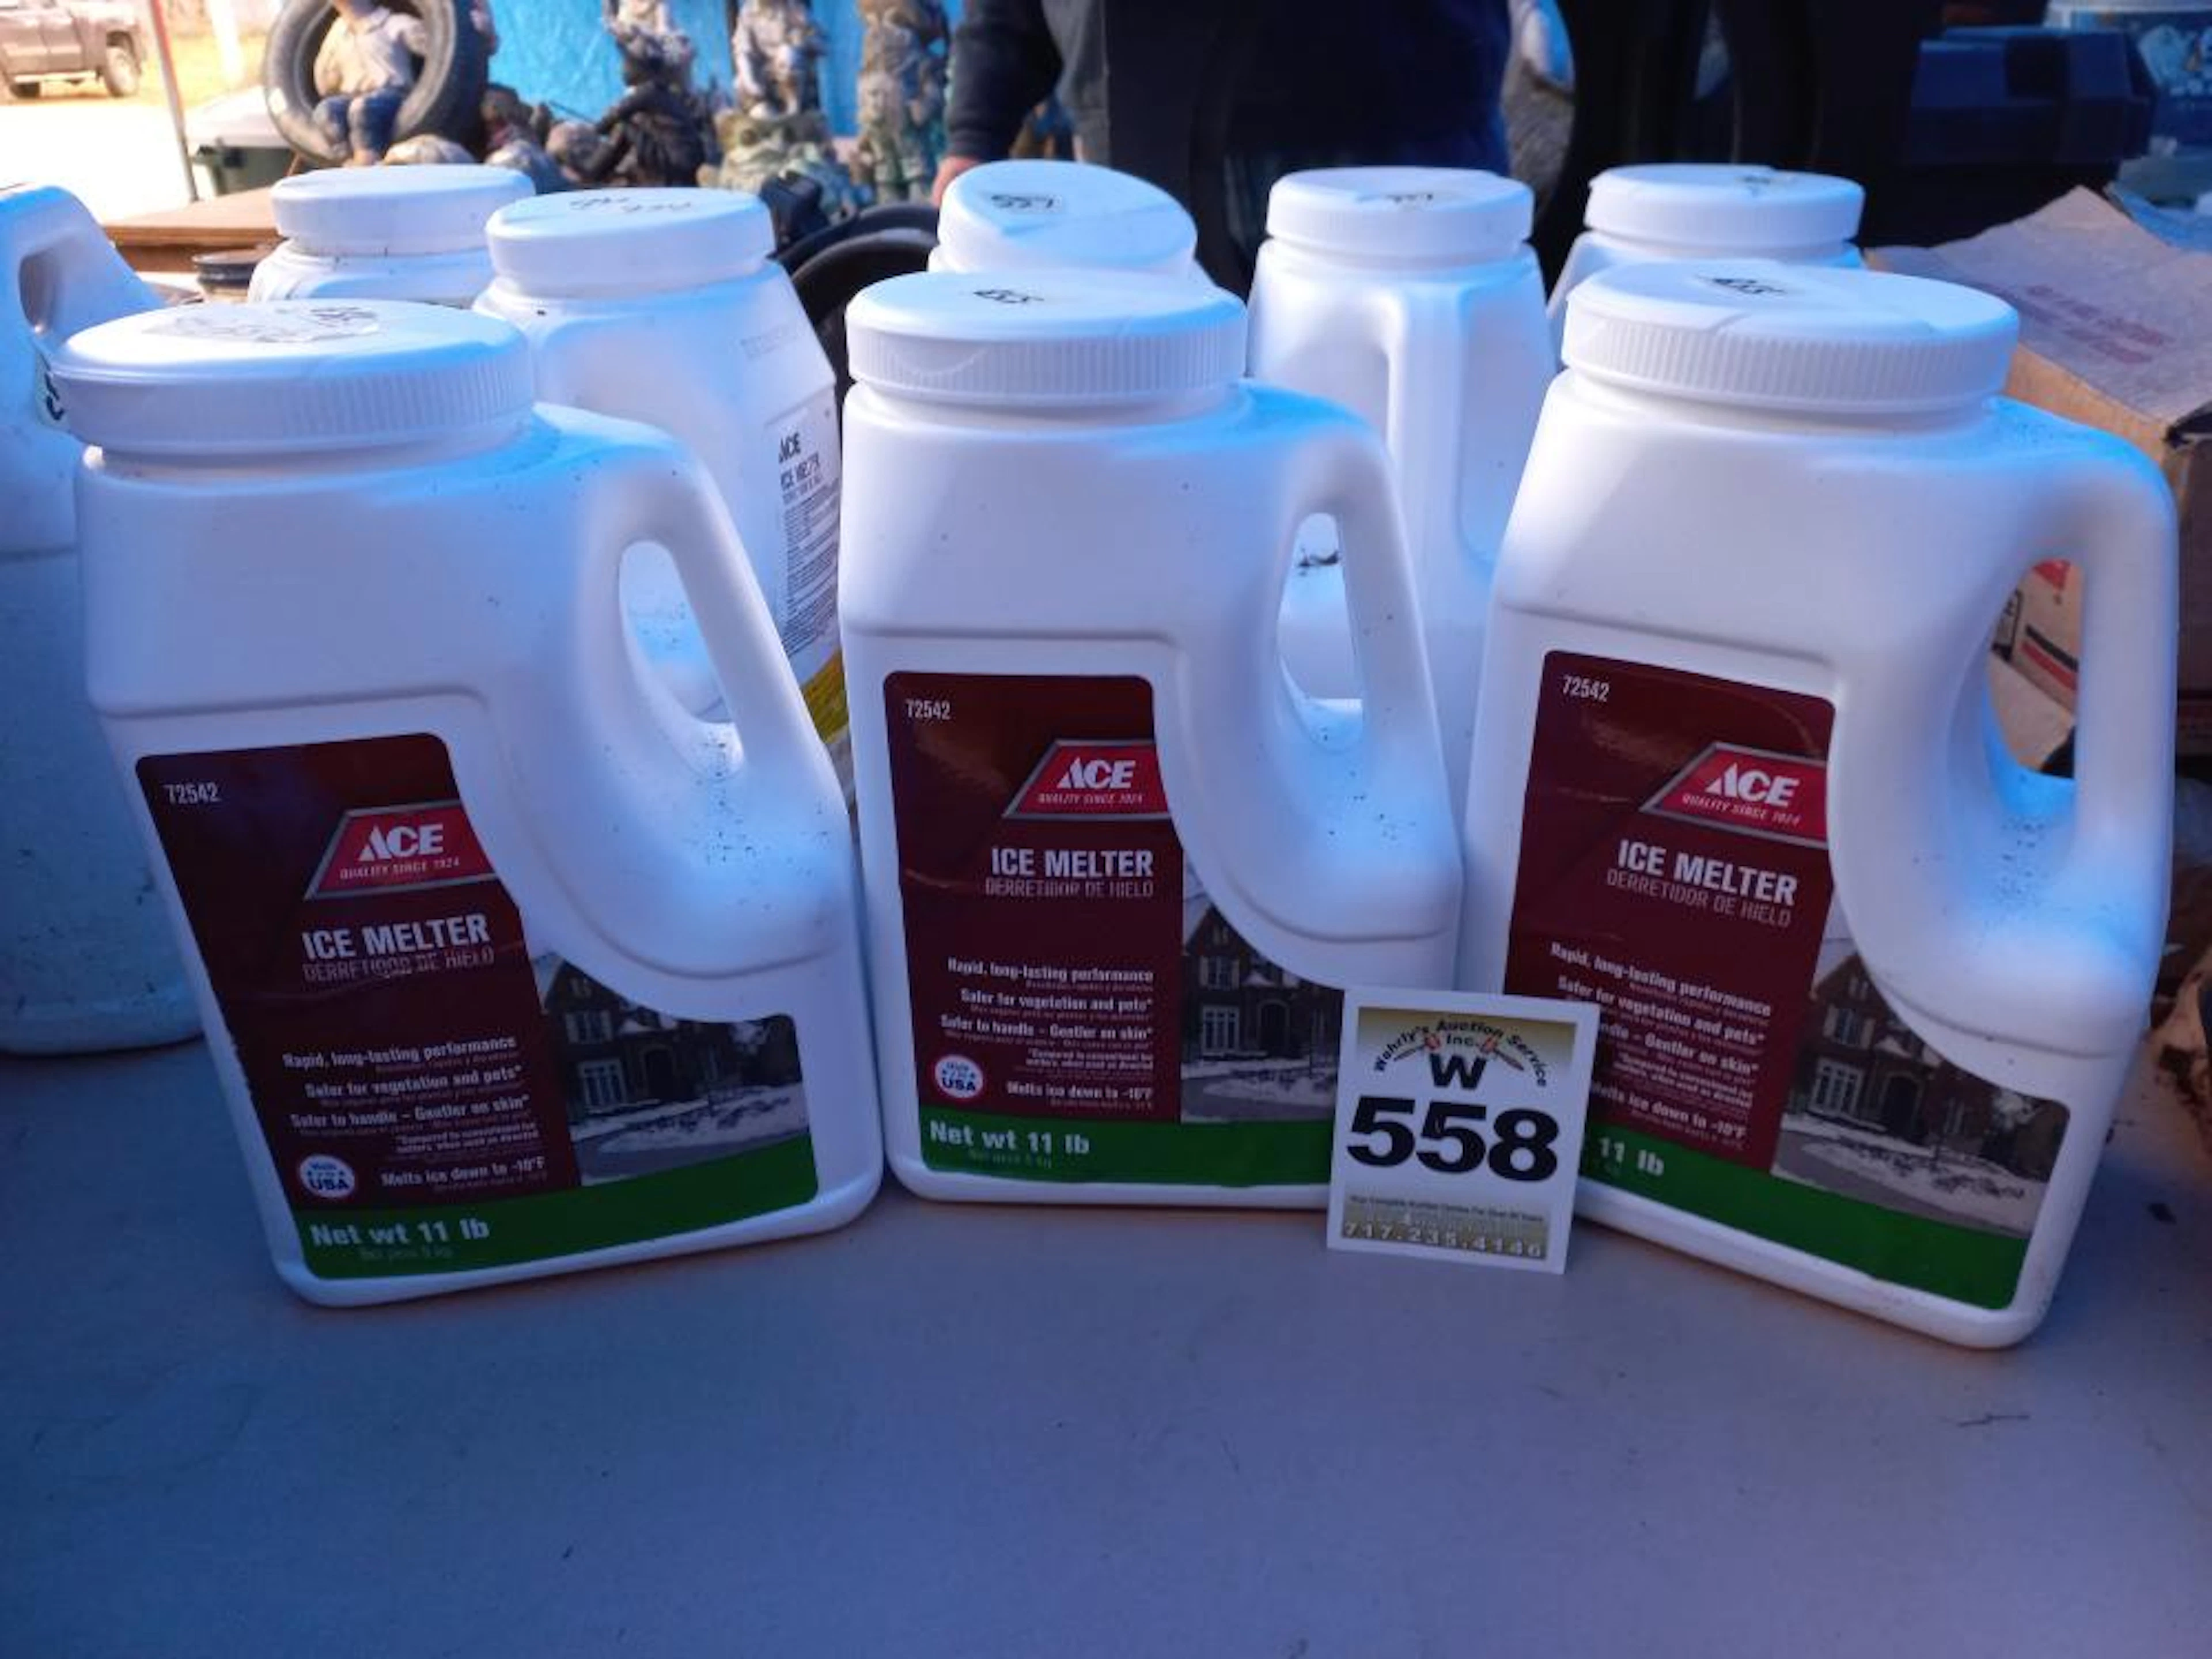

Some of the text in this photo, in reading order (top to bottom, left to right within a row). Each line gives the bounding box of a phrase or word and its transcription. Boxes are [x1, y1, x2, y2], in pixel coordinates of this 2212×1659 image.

[778, 434, 800, 464] ACE
[1563, 674, 1610, 702] 72542
[905, 699, 951, 720] 72542
[1056, 756, 1137, 789] ACE
[1705, 762, 1800, 807] ACE
[164, 782, 221, 805] 72542
[1682, 793, 1730, 812] QUALITY
[358, 824, 444, 862] ACE
[991, 847, 1153, 878] ICE MELTER
[1618, 839, 1798, 907] ICE MELTER
[1085, 879, 1106, 897] DE
[1607, 868, 1791, 929] DERRETIDOR DE HIELO
[302, 912, 490, 960] ICE MELTER
[1071, 968, 1154, 983] performance
[1679, 982, 1771, 1017] performance
[1618, 996, 1692, 1027] vegetation
[1694, 1018, 1722, 1036] and
[423, 1036, 517, 1060] performance
[1436, 1020, 1504, 1037] Auction
[1507, 1035, 1547, 1086] Service
[1447, 1034, 1479, 1047] Inc.
[942, 1077, 976, 1090] USA
[1430, 1054, 1487, 1089] W
[930, 1120, 1090, 1155] Net wt 11 lb
[1347, 1095, 1559, 1182] 558
[1597, 1136, 1625, 1164] 11
[1638, 1149, 1665, 1177] lb
[309, 1179, 349, 1190] USA
[309, 1217, 490, 1247] Net wt 11 lb
